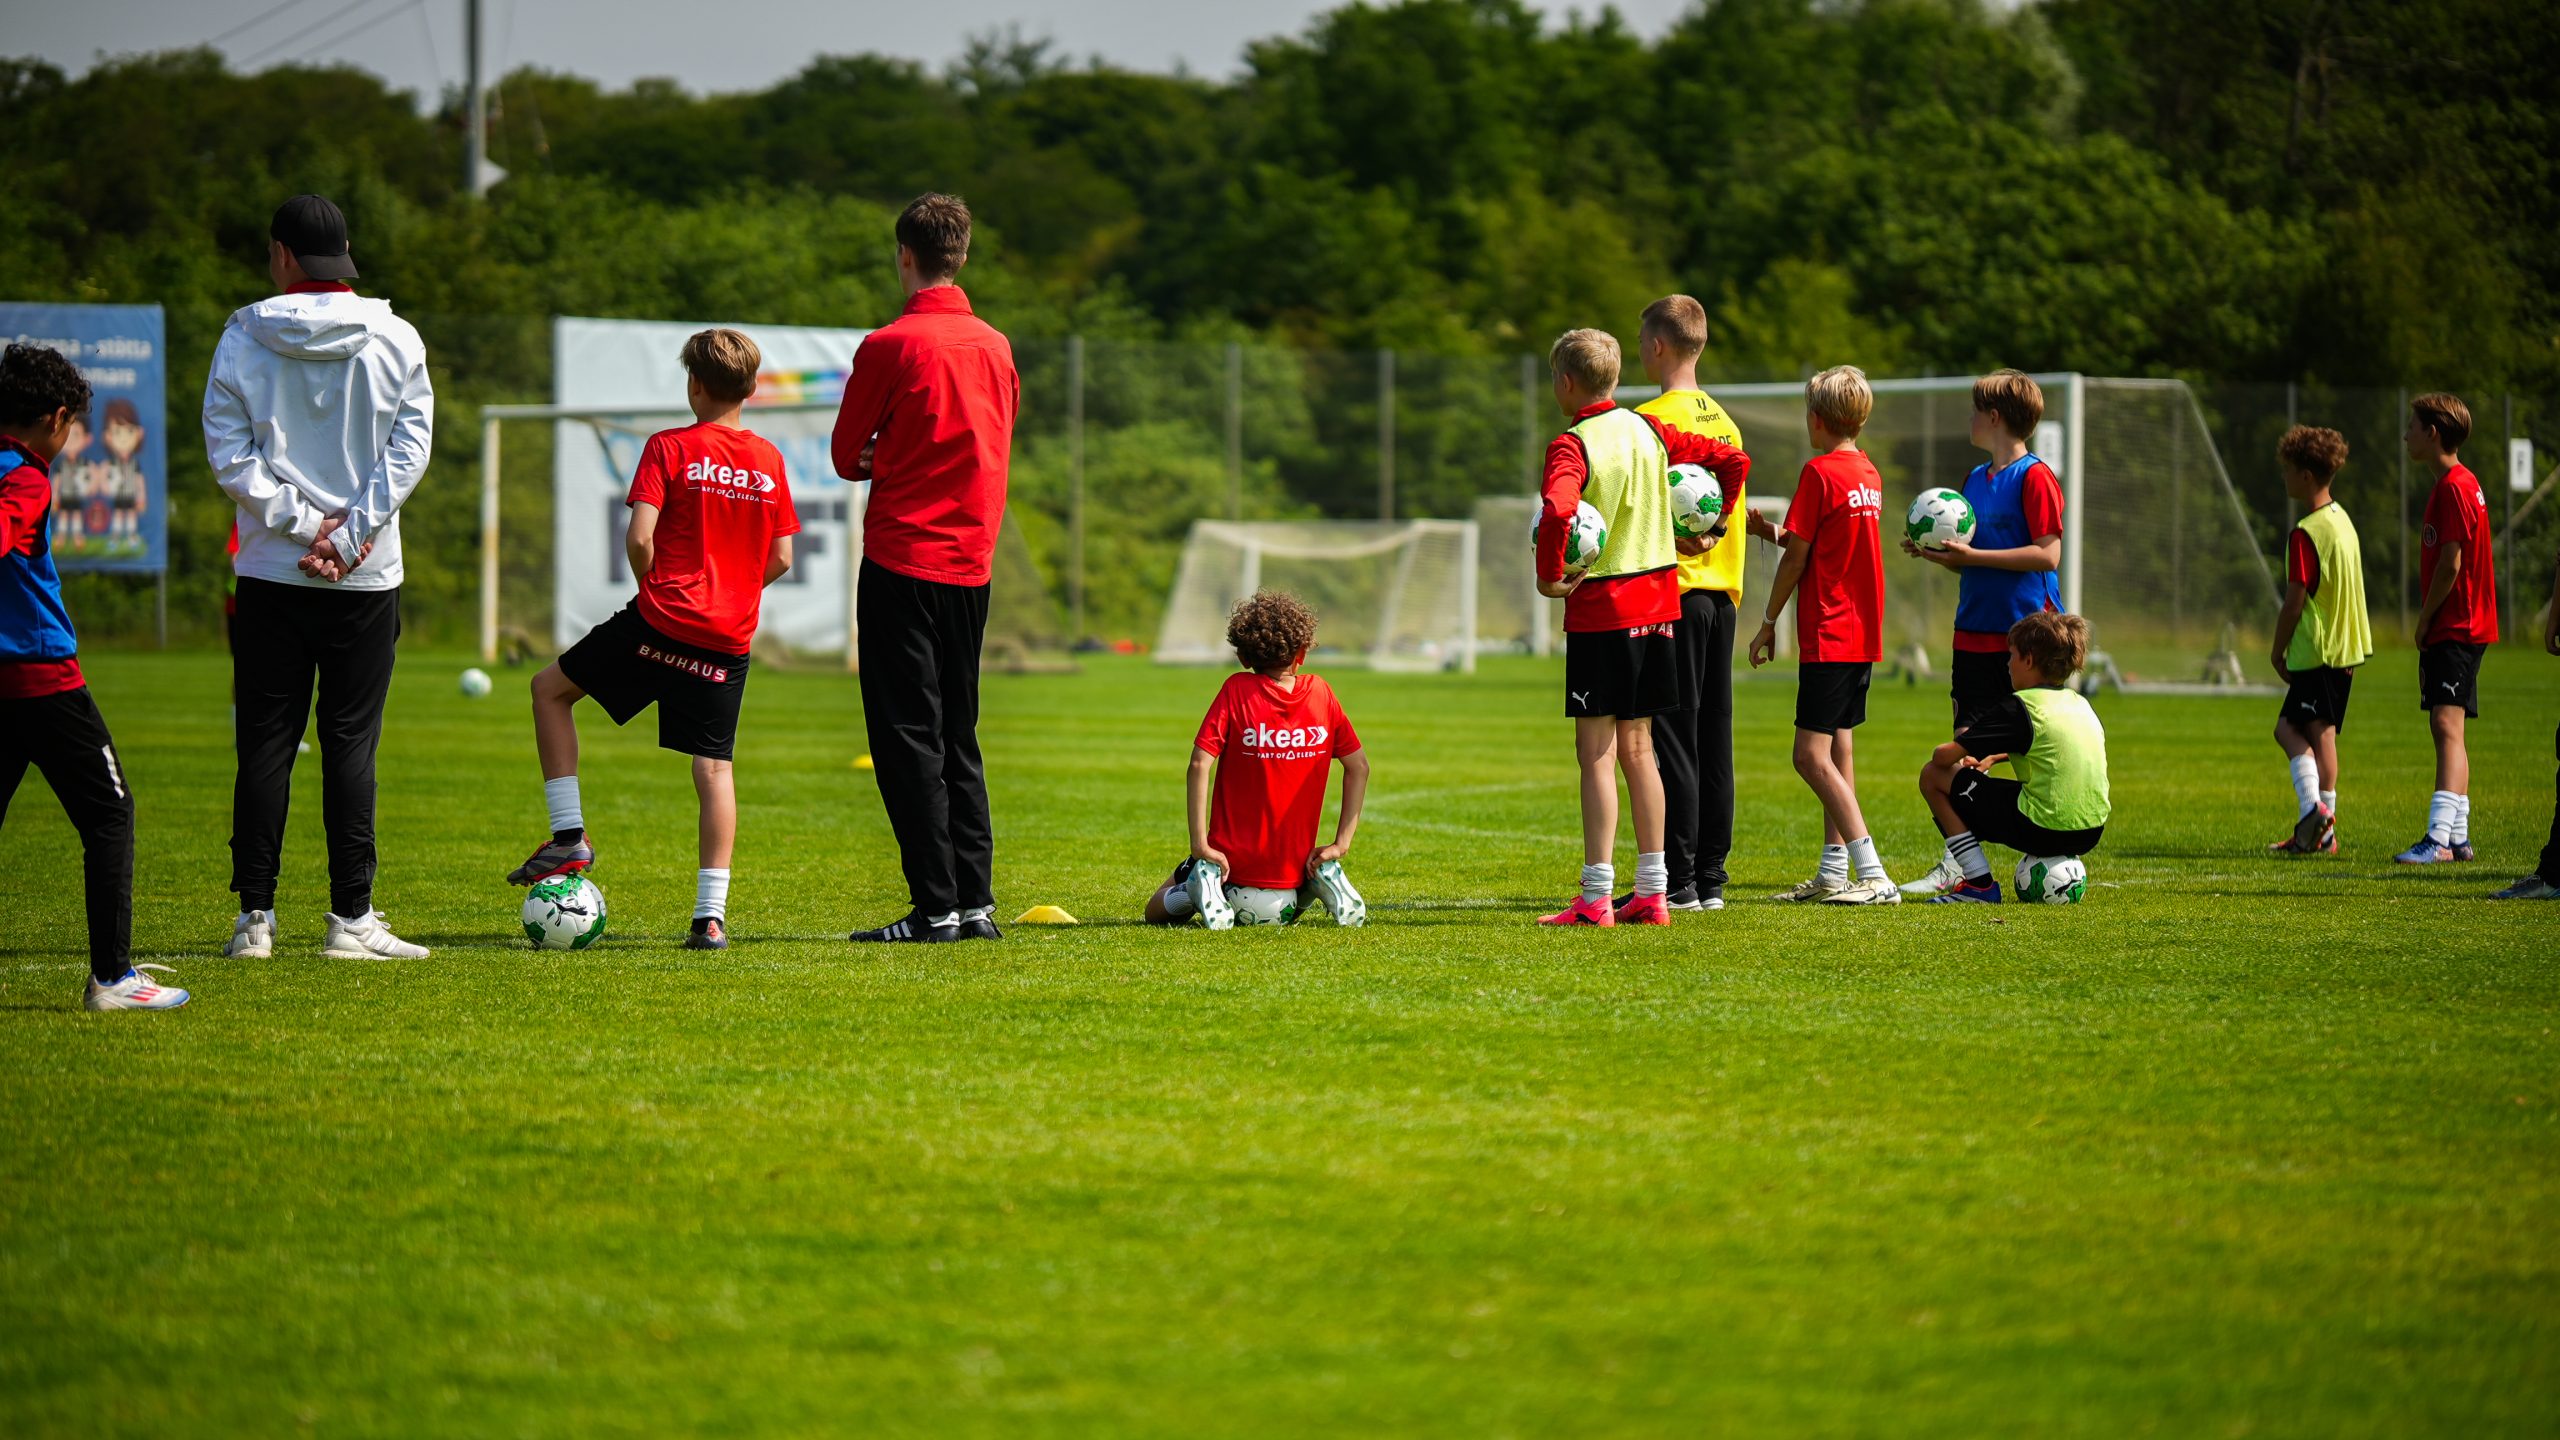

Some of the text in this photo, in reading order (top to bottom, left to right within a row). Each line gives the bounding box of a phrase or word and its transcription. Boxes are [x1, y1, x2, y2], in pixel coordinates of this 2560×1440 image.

[687, 456, 749, 489] akea
[736, 492, 760, 502] ELEDA
[640, 644, 726, 681] BAUHAUS
[1242, 722, 1306, 748] akea
